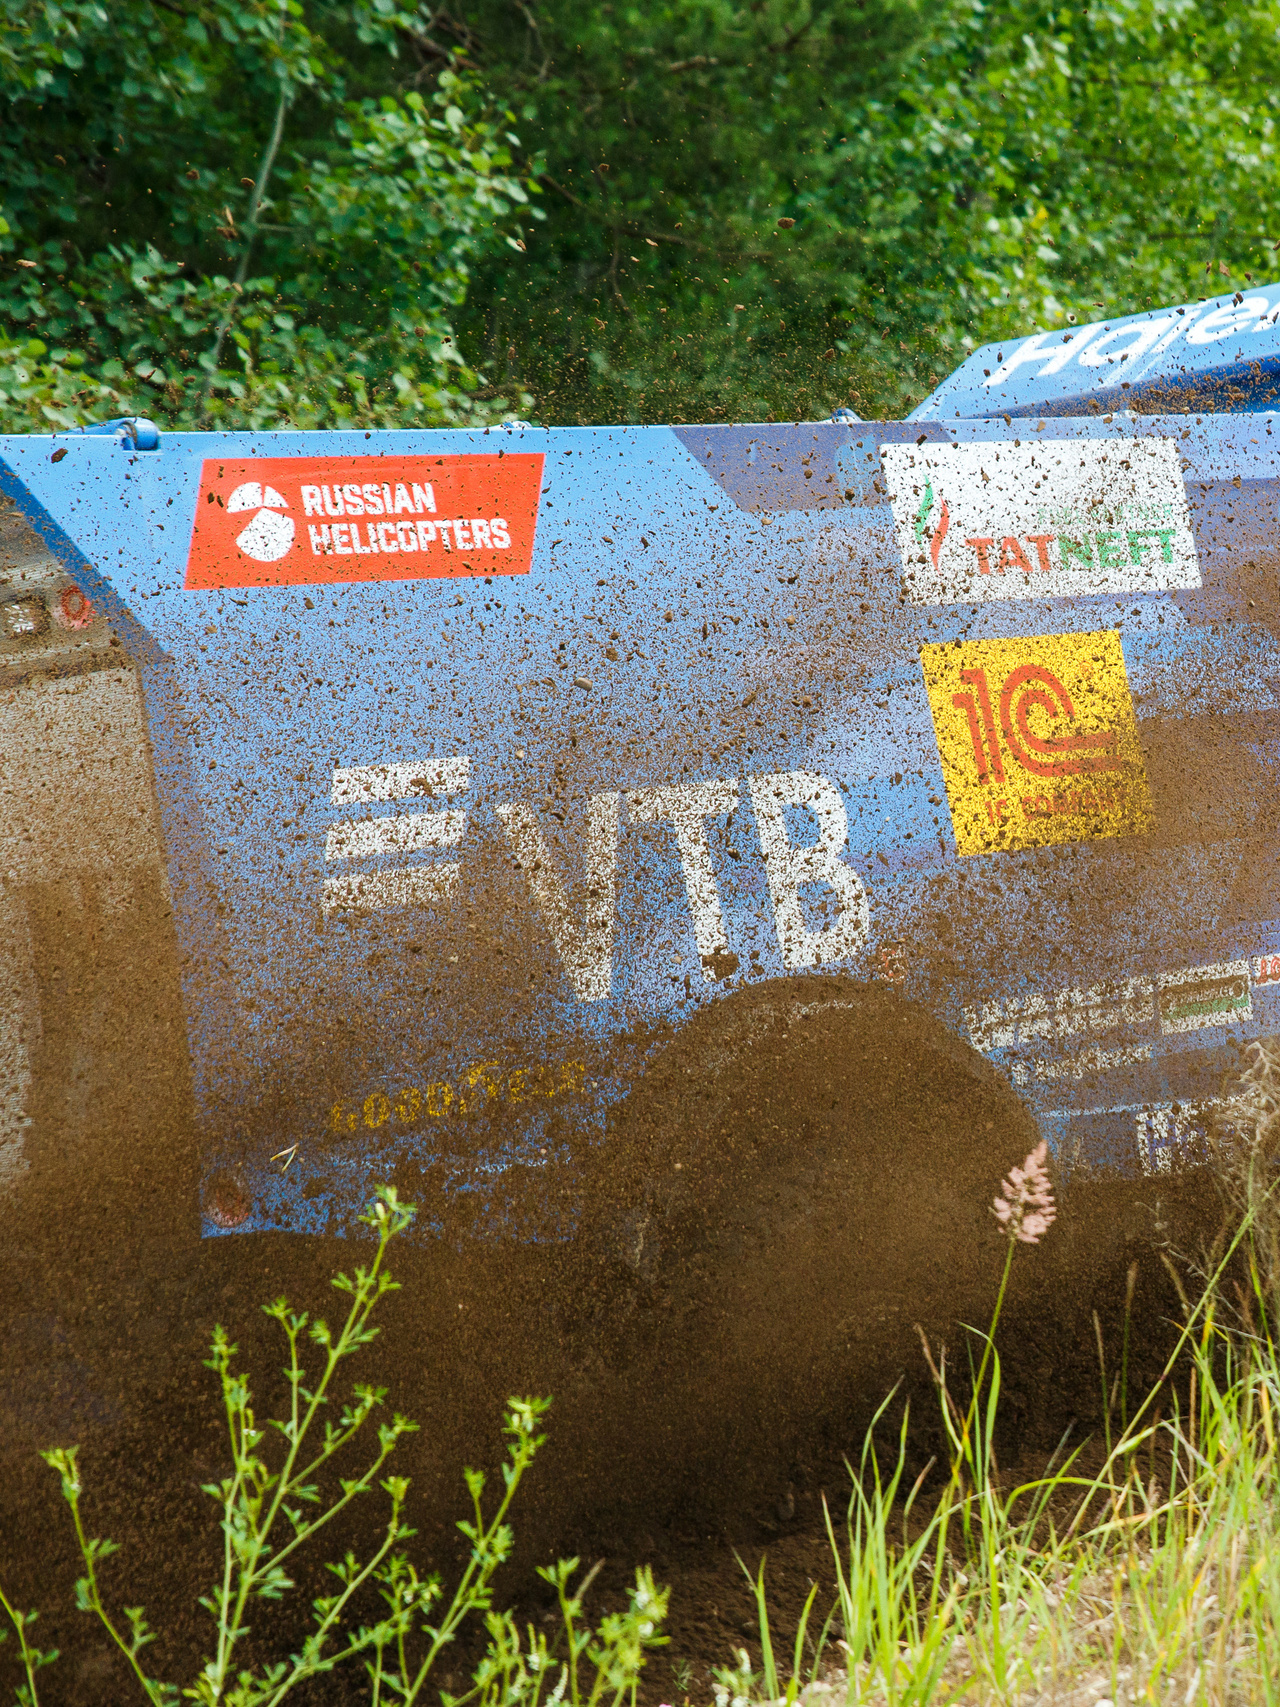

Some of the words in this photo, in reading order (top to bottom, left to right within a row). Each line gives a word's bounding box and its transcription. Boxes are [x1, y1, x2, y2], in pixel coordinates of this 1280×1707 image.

[300, 482, 438, 518] RUSSIAN
[308, 518, 512, 556] HELICOPTERS
[964, 528, 1177, 576] TATNEFT
[496, 770, 871, 1001] VTB
